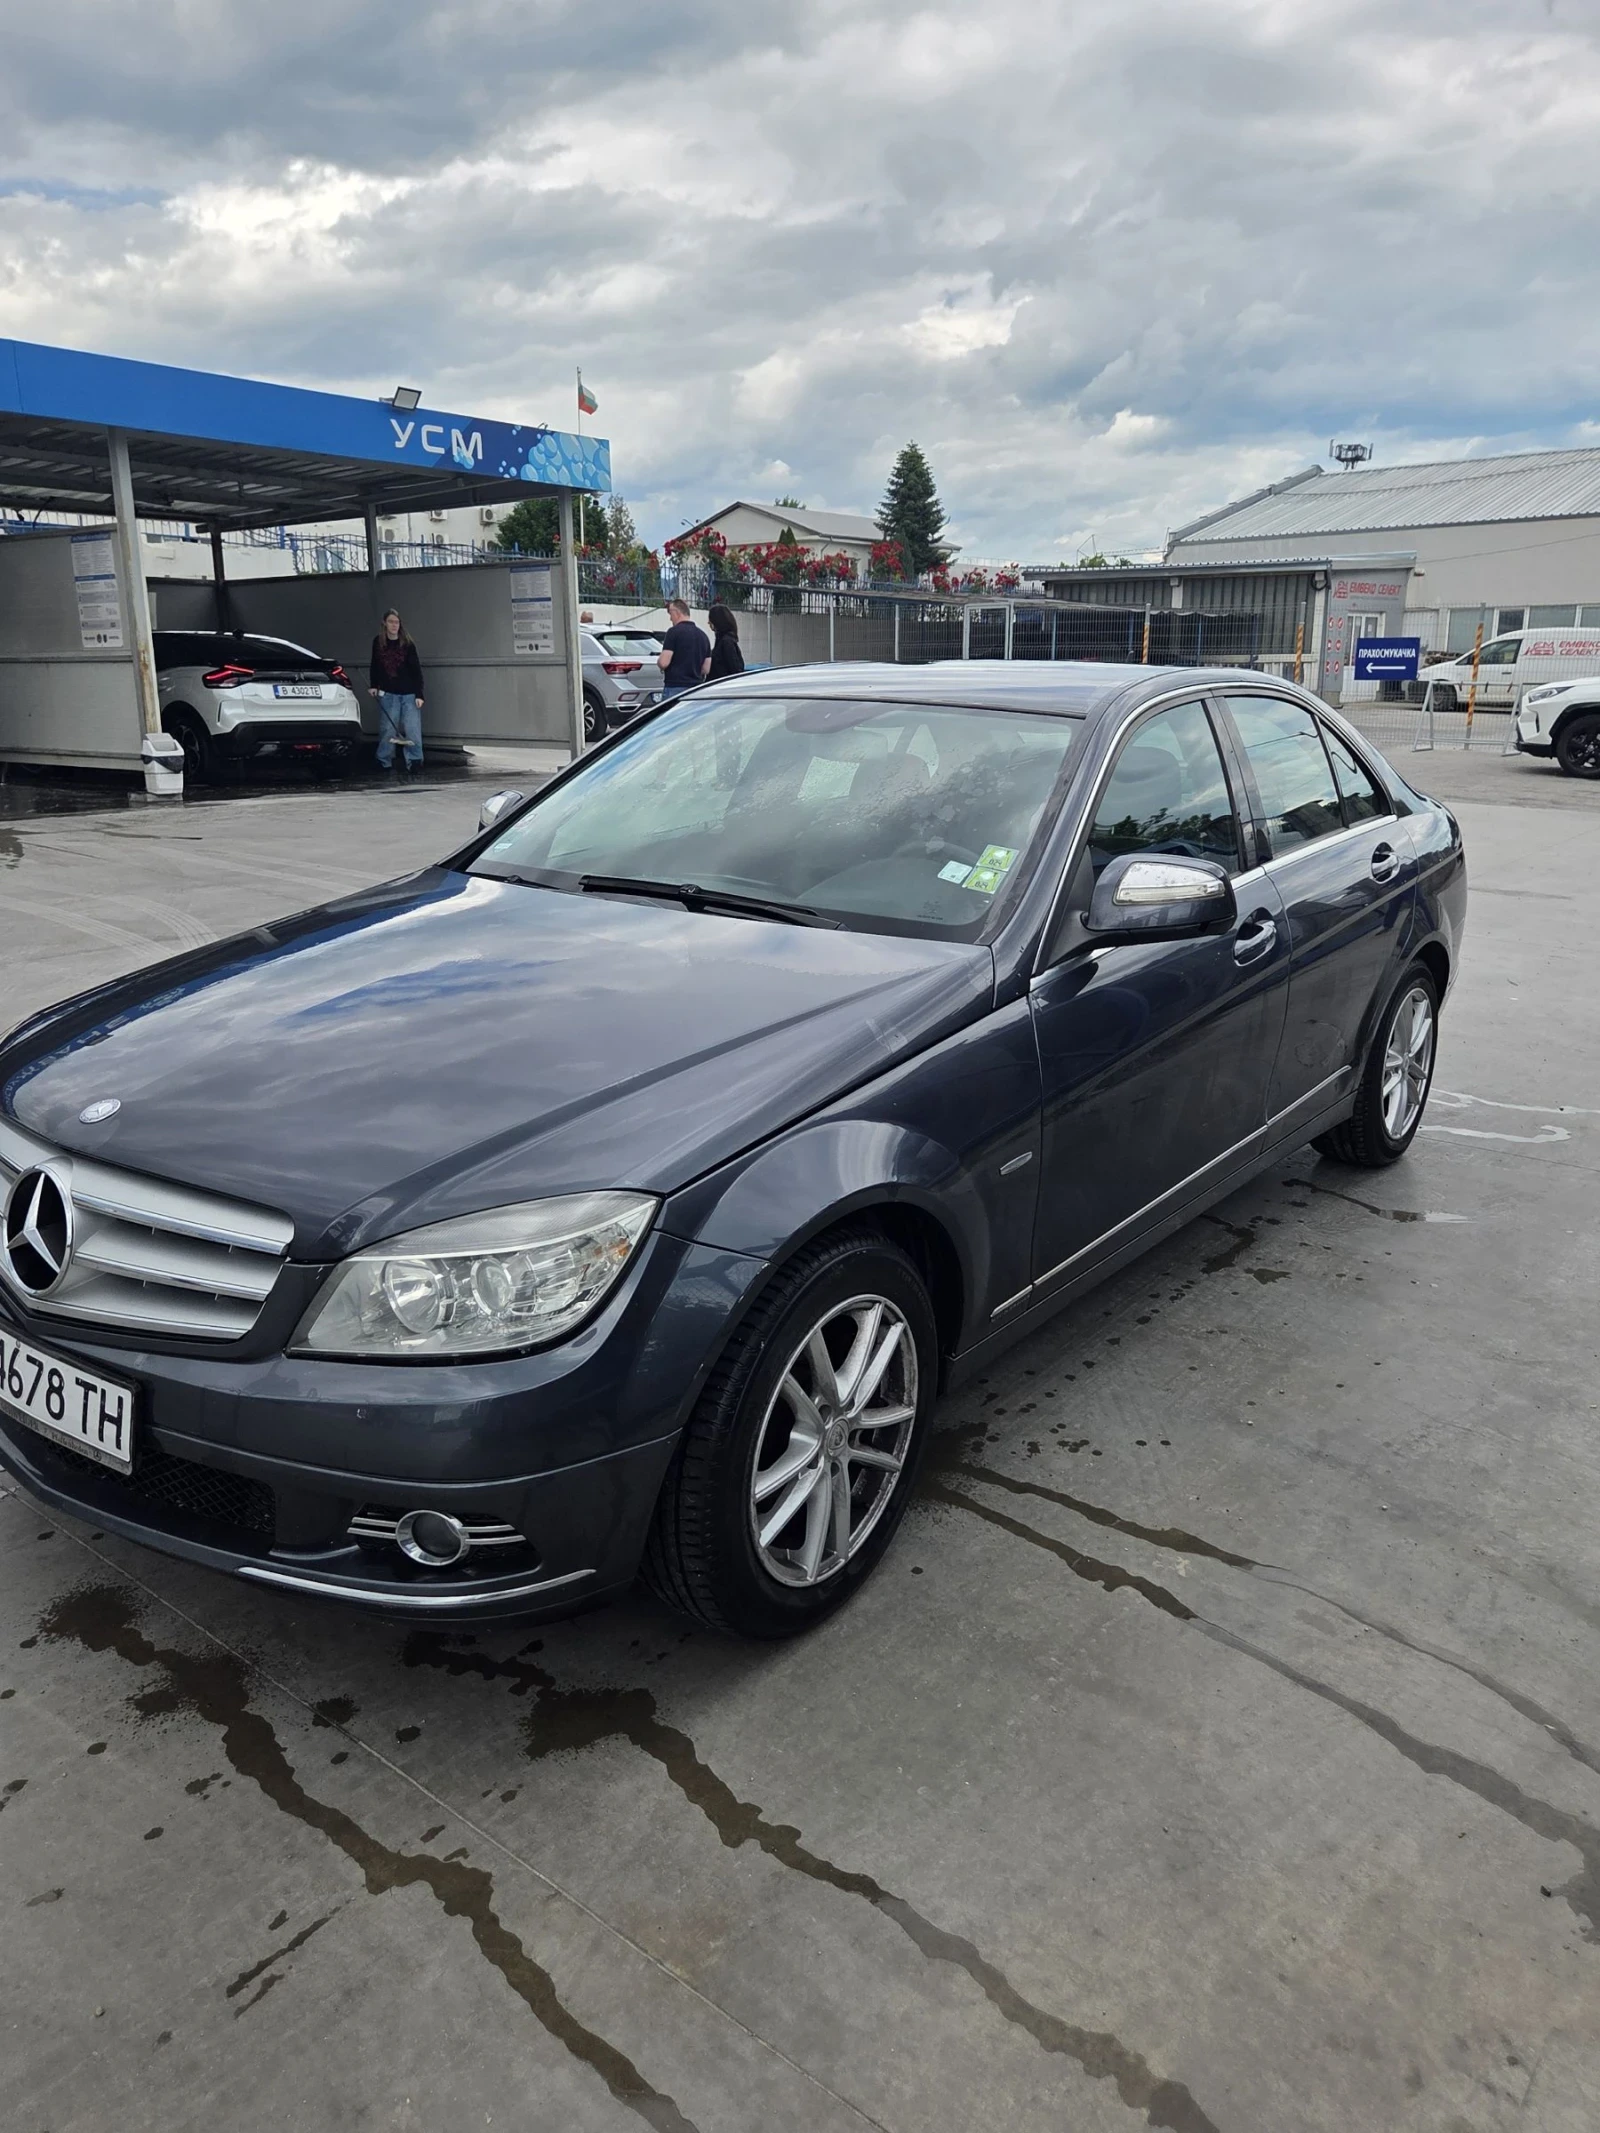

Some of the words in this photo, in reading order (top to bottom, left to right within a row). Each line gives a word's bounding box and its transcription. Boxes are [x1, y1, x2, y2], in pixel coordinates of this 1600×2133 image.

[389, 418, 483, 460] УСМ
[1358, 648, 1416, 658] ПРАХОСМУКАЧКА
[75, 1376, 124, 1451] TH
